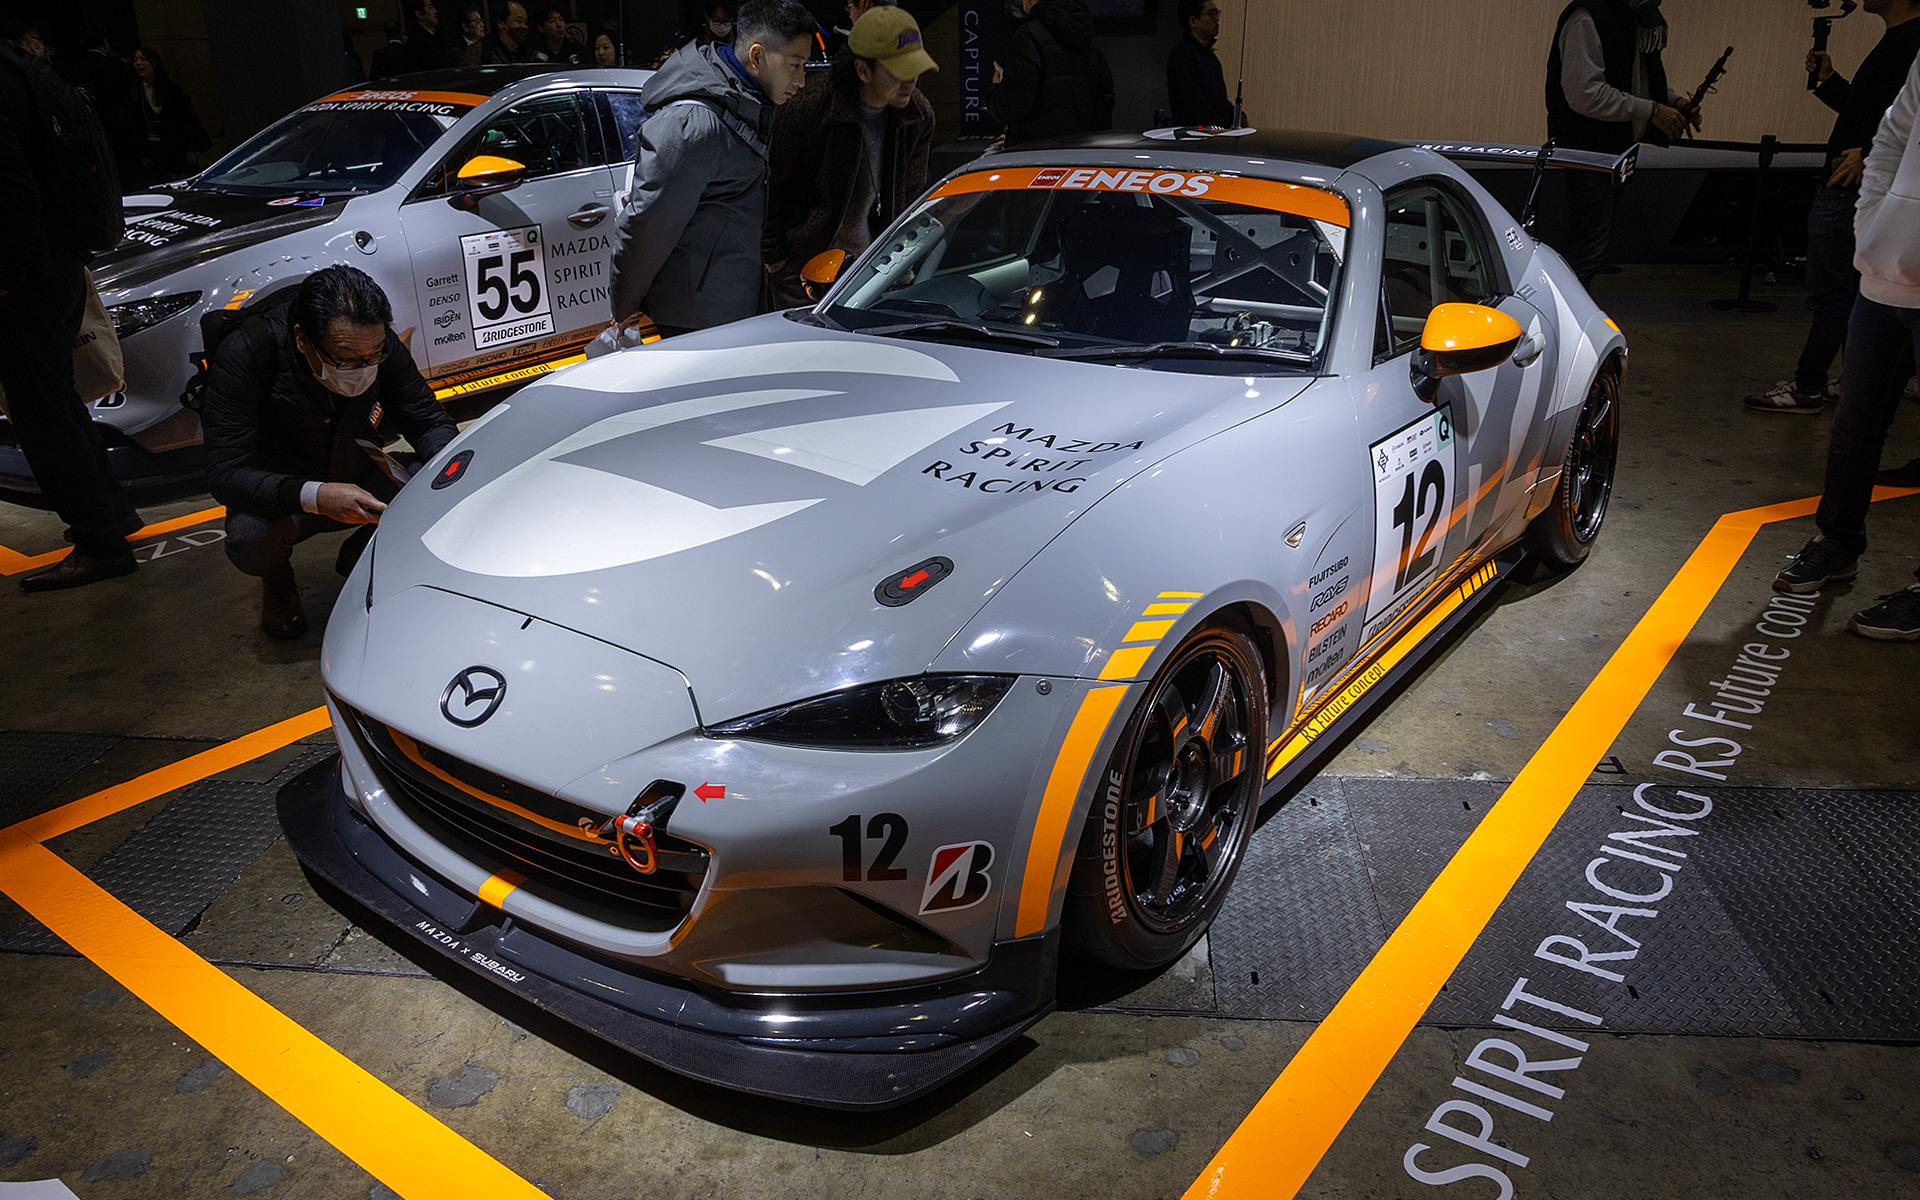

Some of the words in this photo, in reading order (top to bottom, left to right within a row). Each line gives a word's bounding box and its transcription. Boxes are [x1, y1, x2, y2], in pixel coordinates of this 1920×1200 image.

[964, 10, 980, 122] CAPTURE
[338, 102, 387, 111] SPIRIT
[384, 101, 454, 115] RACING
[357, 90, 418, 100] ENEOS
[1060, 169, 1215, 196] ENEOS
[137, 219, 189, 233] SPIRIT
[164, 211, 222, 228] MAZDA
[526, 229, 538, 244] Q
[551, 234, 611, 259] MAZDA
[426, 273, 459, 288] Garrett
[477, 248, 541, 321] 55
[554, 260, 602, 284] SPIRIT
[429, 292, 461, 307] DENSO
[433, 312, 462, 326] IBIDEN
[482, 320, 547, 344] BRIDGESTONE
[434, 331, 466, 346] molten
[476, 351, 508, 365] RECARO
[514, 344, 536, 356] TONE
[504, 362, 552, 381] concept
[991, 421, 1145, 453] MAZDA
[1438, 414, 1450, 442] Q
[959, 440, 1093, 472] SPIRIT
[920, 459, 1088, 494] RACING
[1392, 458, 1446, 596] 12
[1308, 555, 1349, 589] FUJITSUBO
[1309, 574, 1350, 613] RAYS
[1309, 600, 1348, 638] RECARO
[1308, 623, 1348, 664] BILSTEIN
[1306, 646, 1344, 685] molten
[1300, 724, 1320, 743] RS
[1316, 694, 1350, 729] Future
[1347, 661, 1386, 699] concept
[1682, 642, 1791, 731] Future
[1652, 728, 1743, 782] RS
[829, 812, 909, 882] 12
[1102, 769, 1128, 925] BRIDGESTONE
[918, 839, 996, 916] B
[1533, 782, 1714, 984] RACING
[415, 920, 460, 950] MAZDA
[471, 952, 526, 982] SUBARU
[1403, 977, 1604, 1200] SPIRIT
